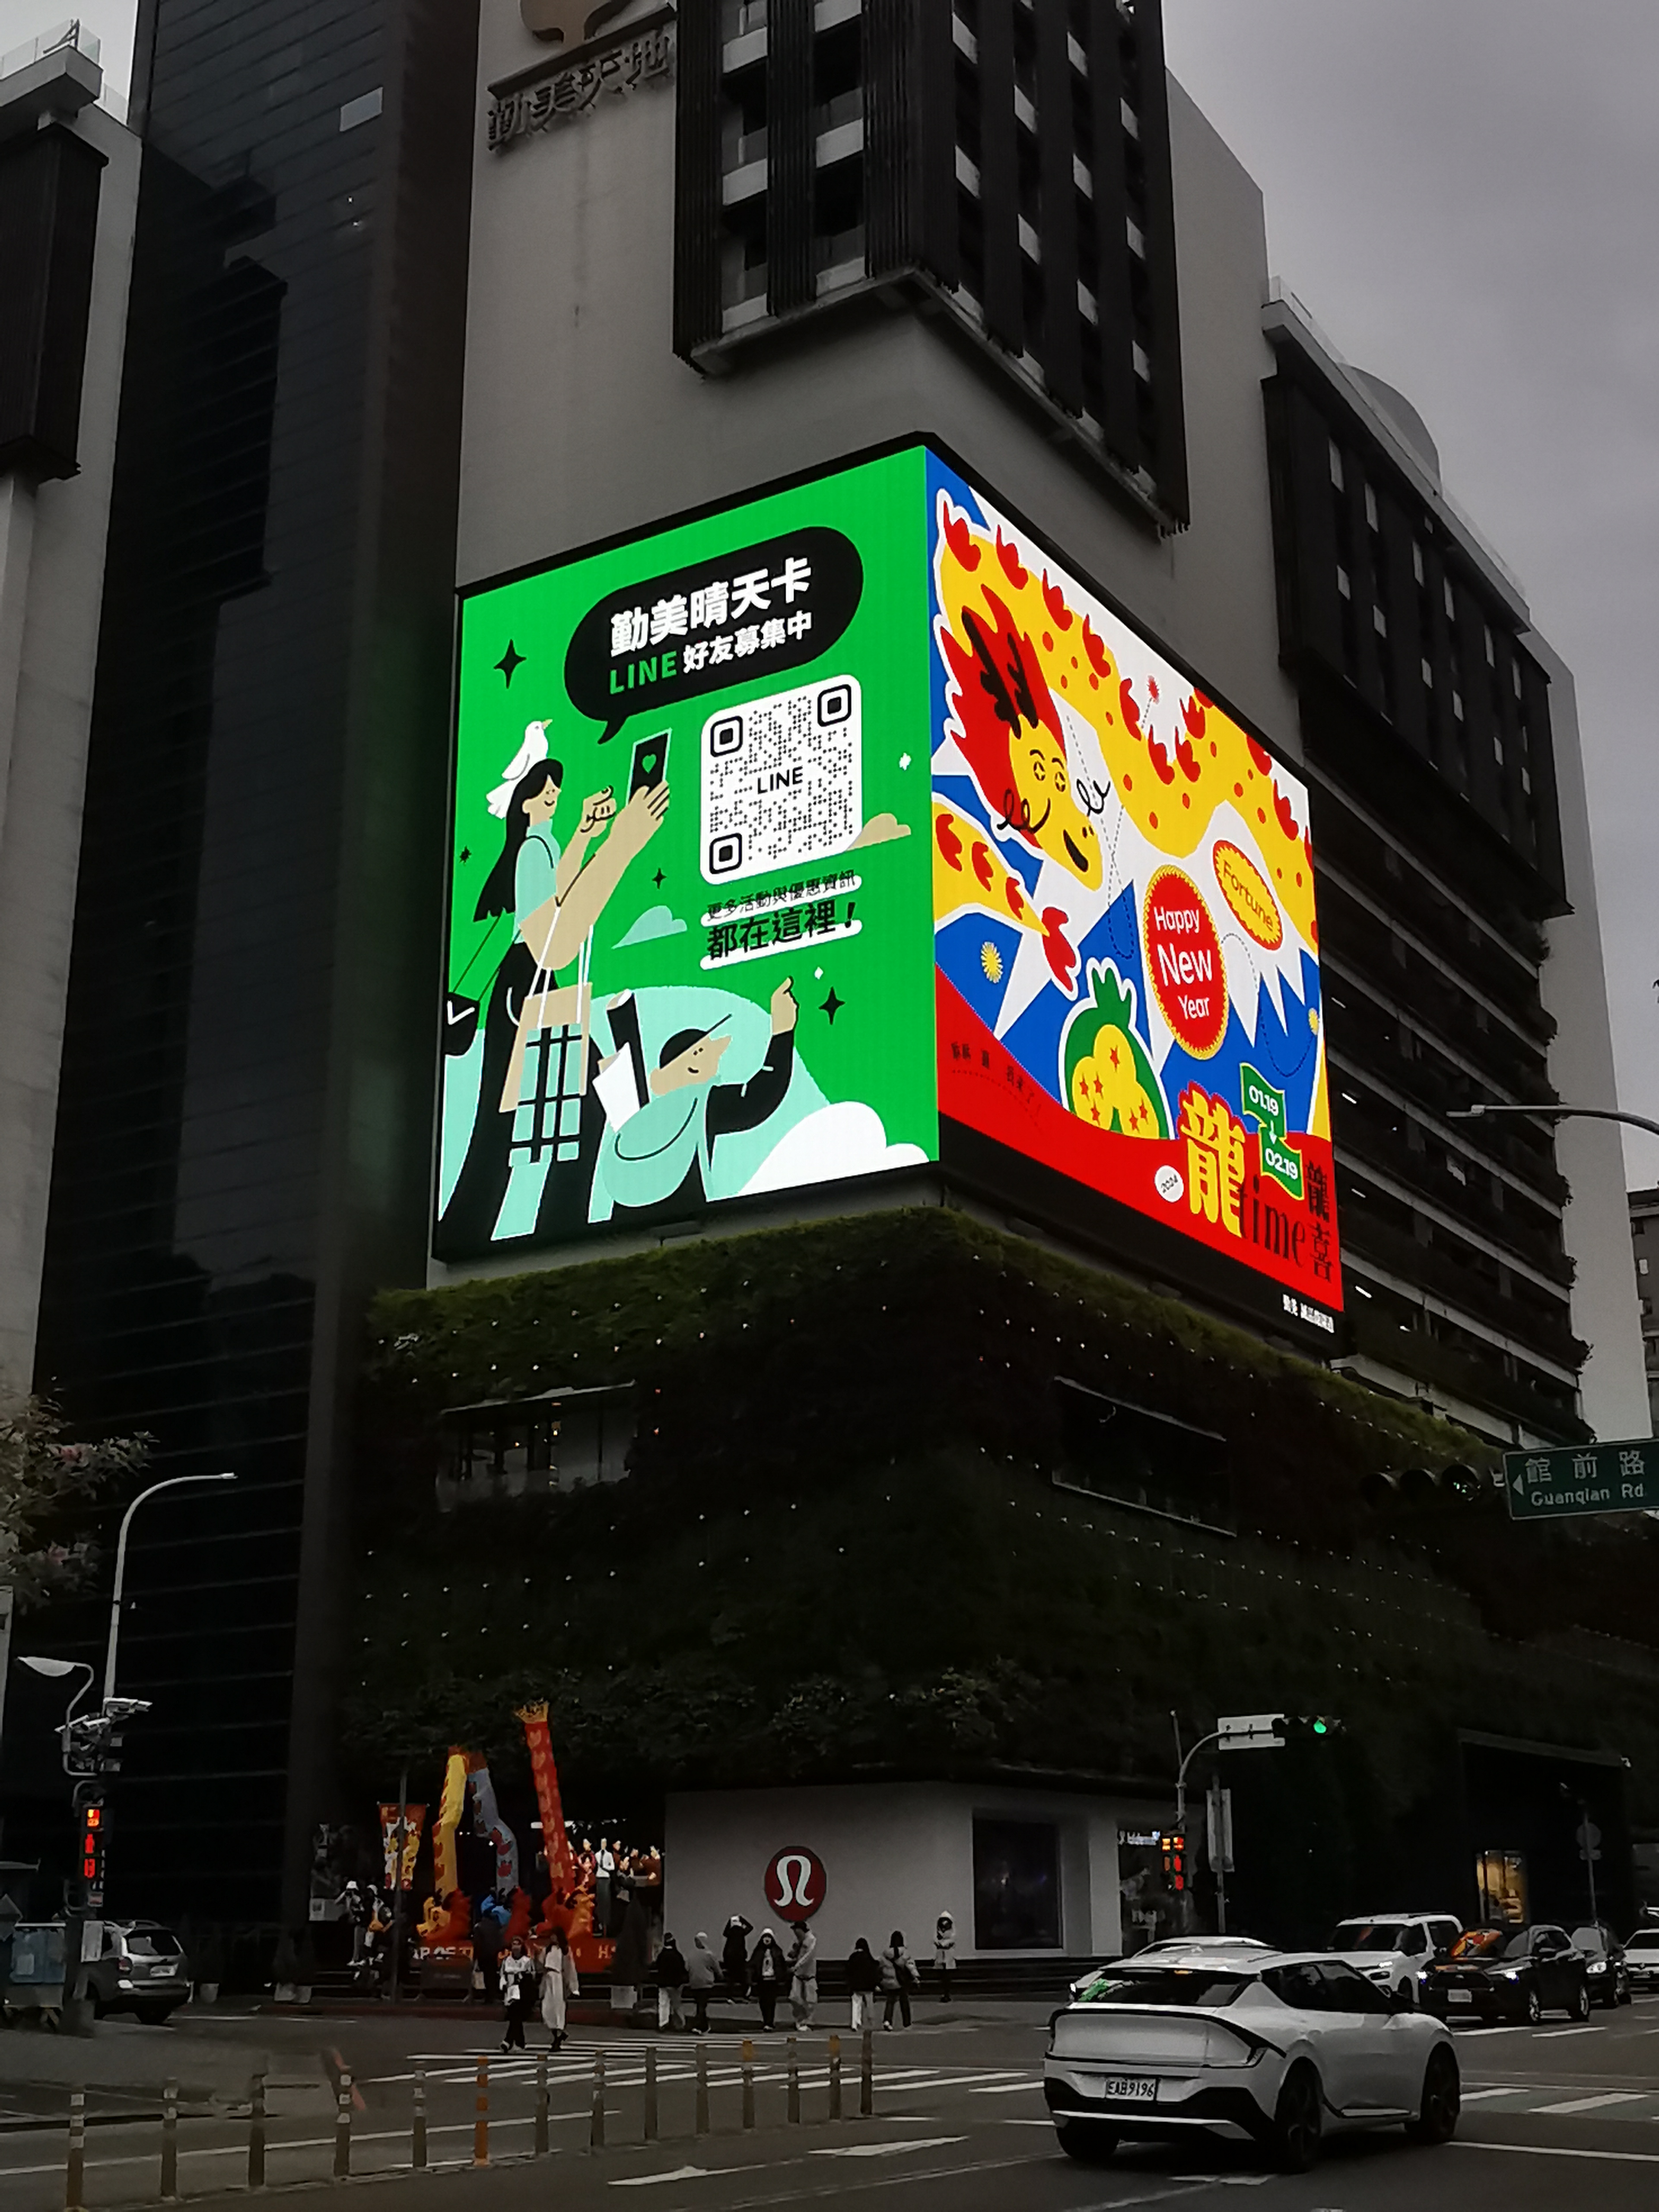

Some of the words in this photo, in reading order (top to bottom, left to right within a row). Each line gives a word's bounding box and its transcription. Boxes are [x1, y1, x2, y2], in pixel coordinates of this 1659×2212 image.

[610, 557, 811, 657] 勤美晴天卡
[610, 650, 677, 695] LINE
[683, 610, 812, 674] 好友募集中
[757, 766, 803, 795] LINE
[1223, 860, 1274, 931] Fortune
[1154, 906, 1200, 934] Happy
[1157, 943, 1213, 987] New
[1178, 995, 1210, 1020] Year
[1525, 1449, 1645, 1484] 館前路
[1531, 1487, 1611, 1506] Guanqian
